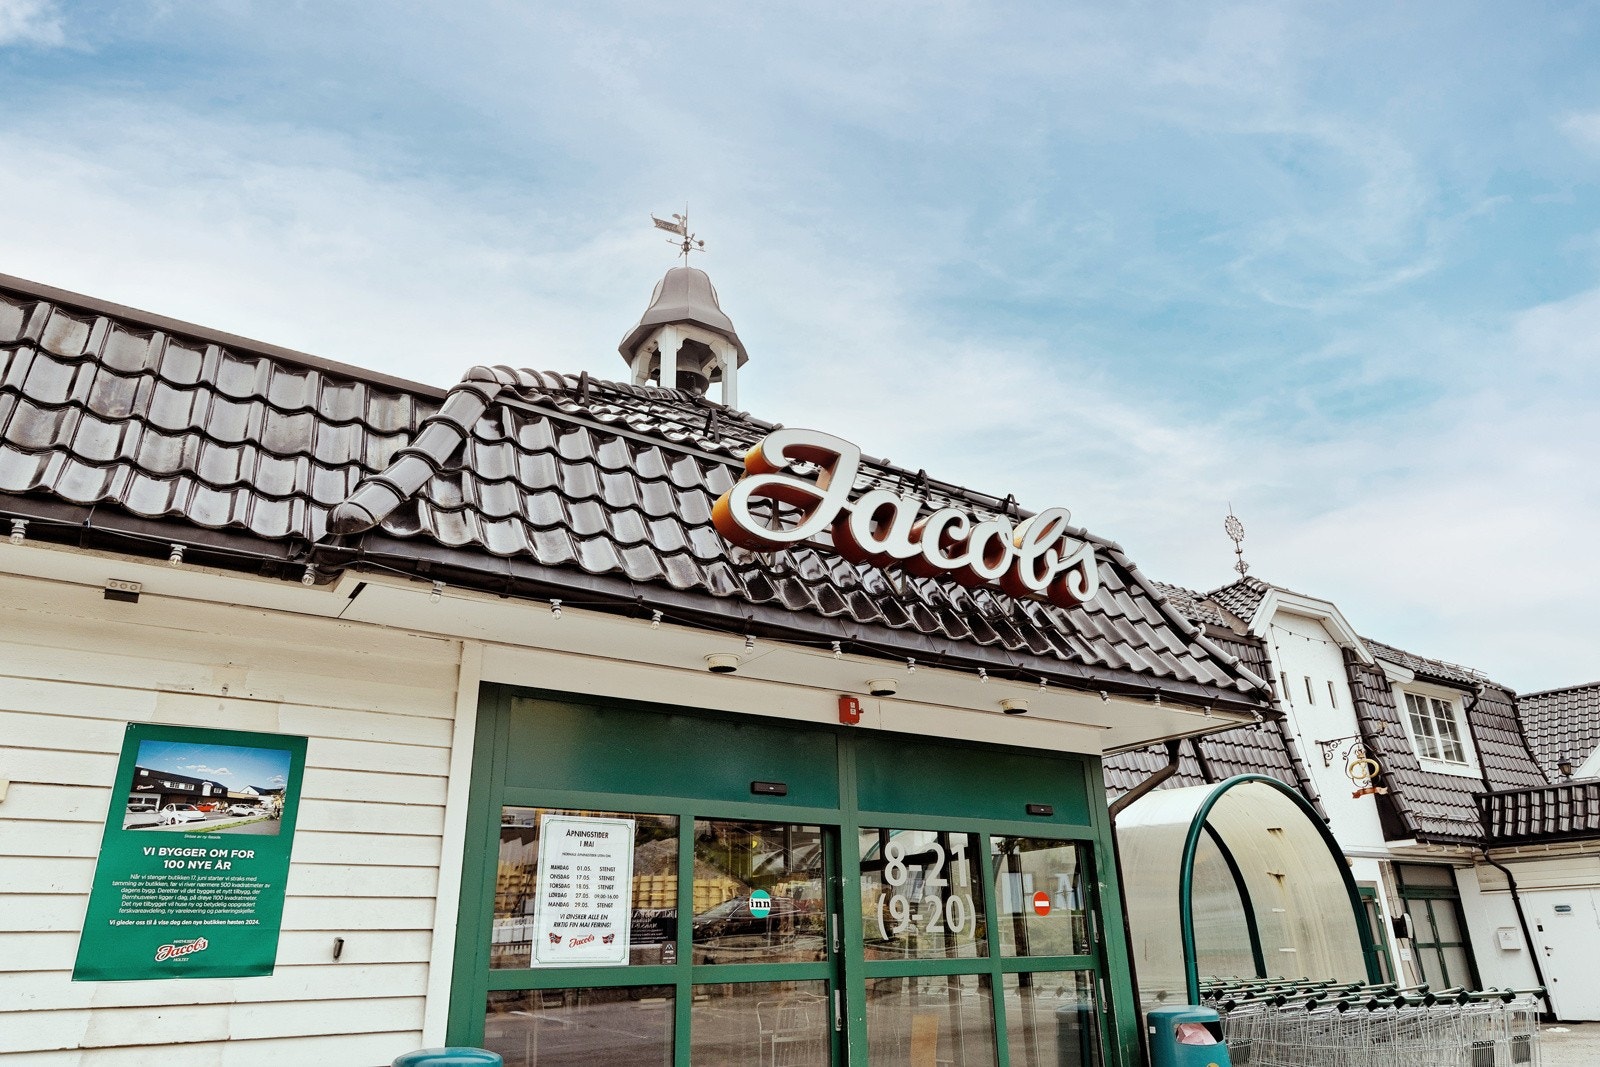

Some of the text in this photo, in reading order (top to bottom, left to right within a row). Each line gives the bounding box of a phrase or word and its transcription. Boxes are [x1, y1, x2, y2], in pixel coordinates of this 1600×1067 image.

[566, 829, 608, 838] ÅPNINGSTIDER
[143, 847, 255, 858] VI BYGGER OM FOR
[164, 860, 231, 870] 100 NYE ÅR
[885, 841, 967, 887] 8-21
[751, 899, 770, 907] inn
[878, 893, 976, 940] (9-20)
